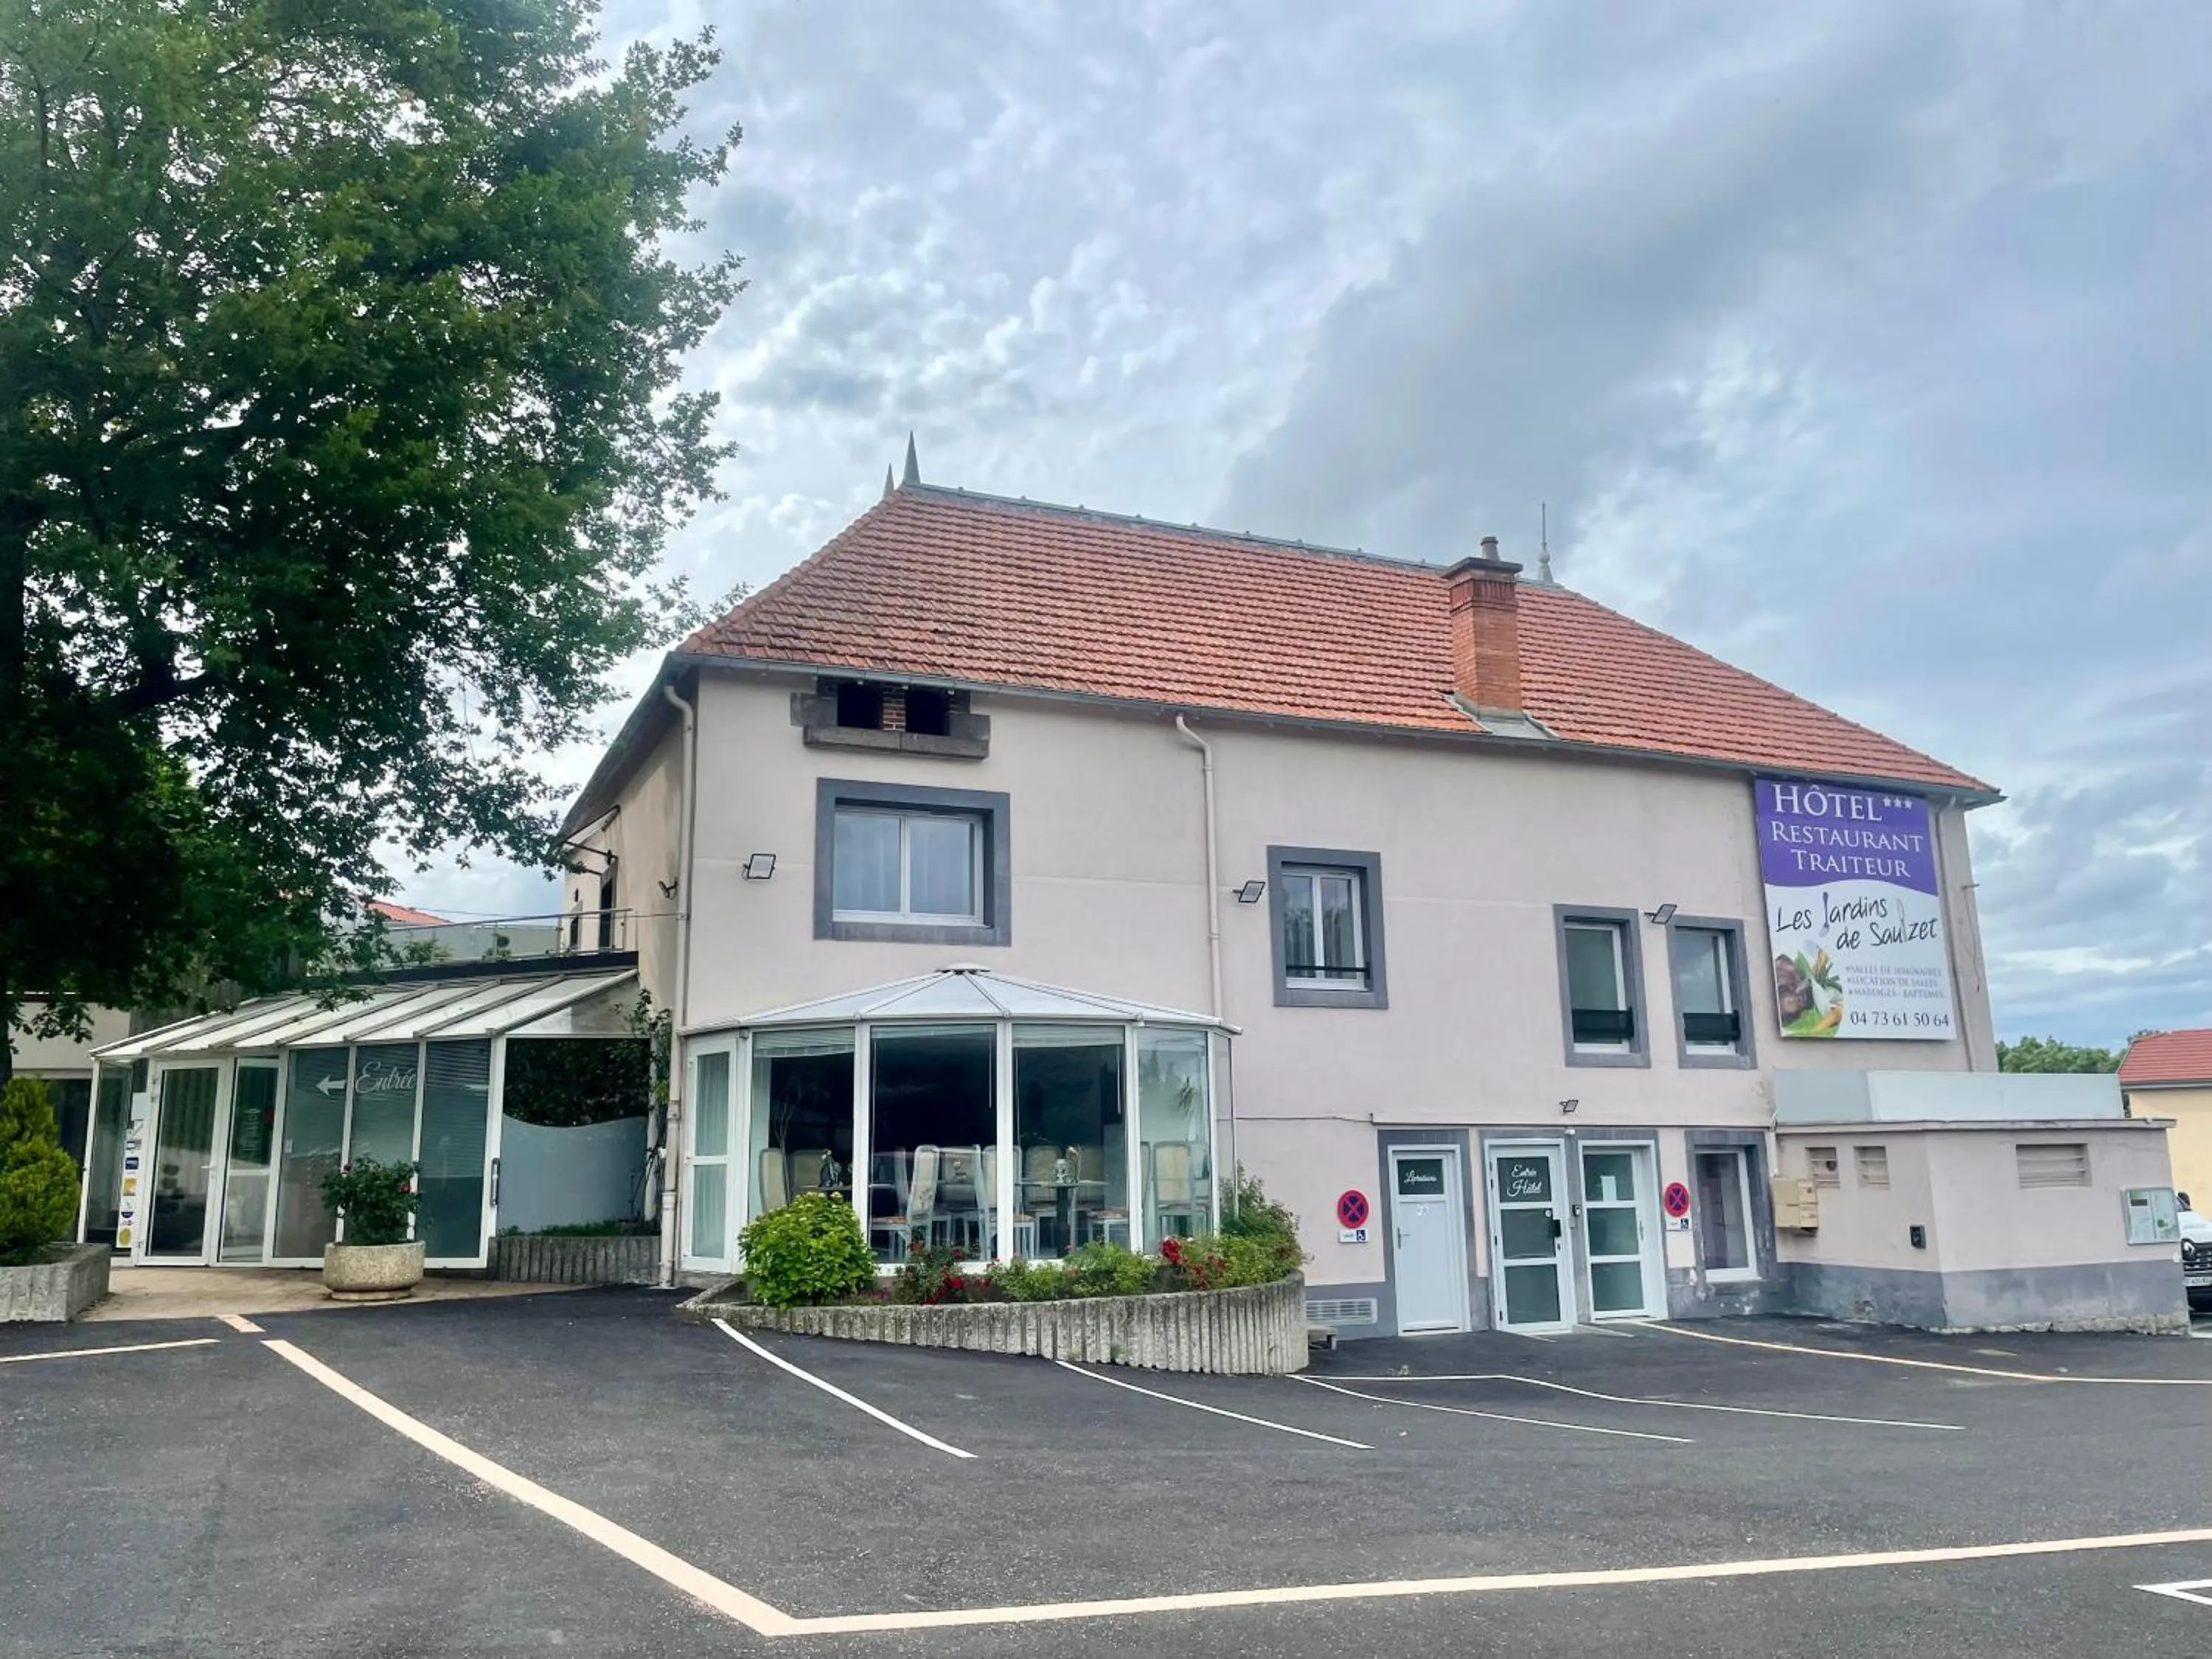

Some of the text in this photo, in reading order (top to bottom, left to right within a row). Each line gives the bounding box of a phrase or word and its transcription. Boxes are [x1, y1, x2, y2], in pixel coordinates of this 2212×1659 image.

[1773, 784, 1882, 821] HÔTEL
[1771, 821, 1924, 852] RESTAURANT
[1791, 849, 1911, 878] TRAITEUR
[1776, 892, 1888, 936] Les Jardins
[1837, 927, 1860, 950] de
[1850, 1011, 1949, 1026] 04 73 61 50 64
[355, 1061, 417, 1093] Entrée
